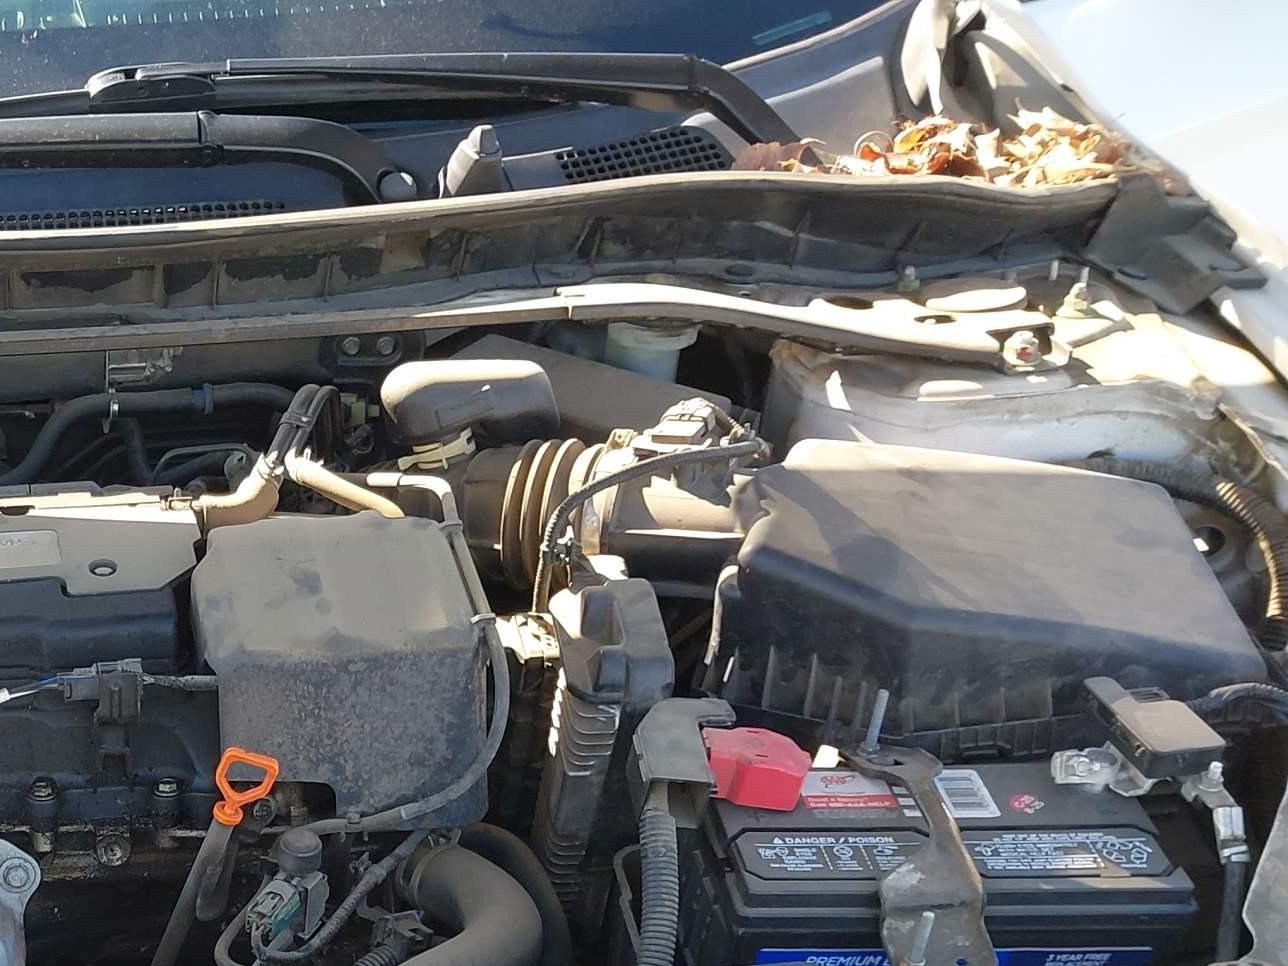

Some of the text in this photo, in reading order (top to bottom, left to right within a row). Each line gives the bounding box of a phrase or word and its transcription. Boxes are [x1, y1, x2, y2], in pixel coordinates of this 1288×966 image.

[785, 836, 836, 845] DANGER
[848, 835, 895, 844] POISON
[1056, 953, 1083, 962] YEAR
[1083, 952, 1112, 961] FREE
